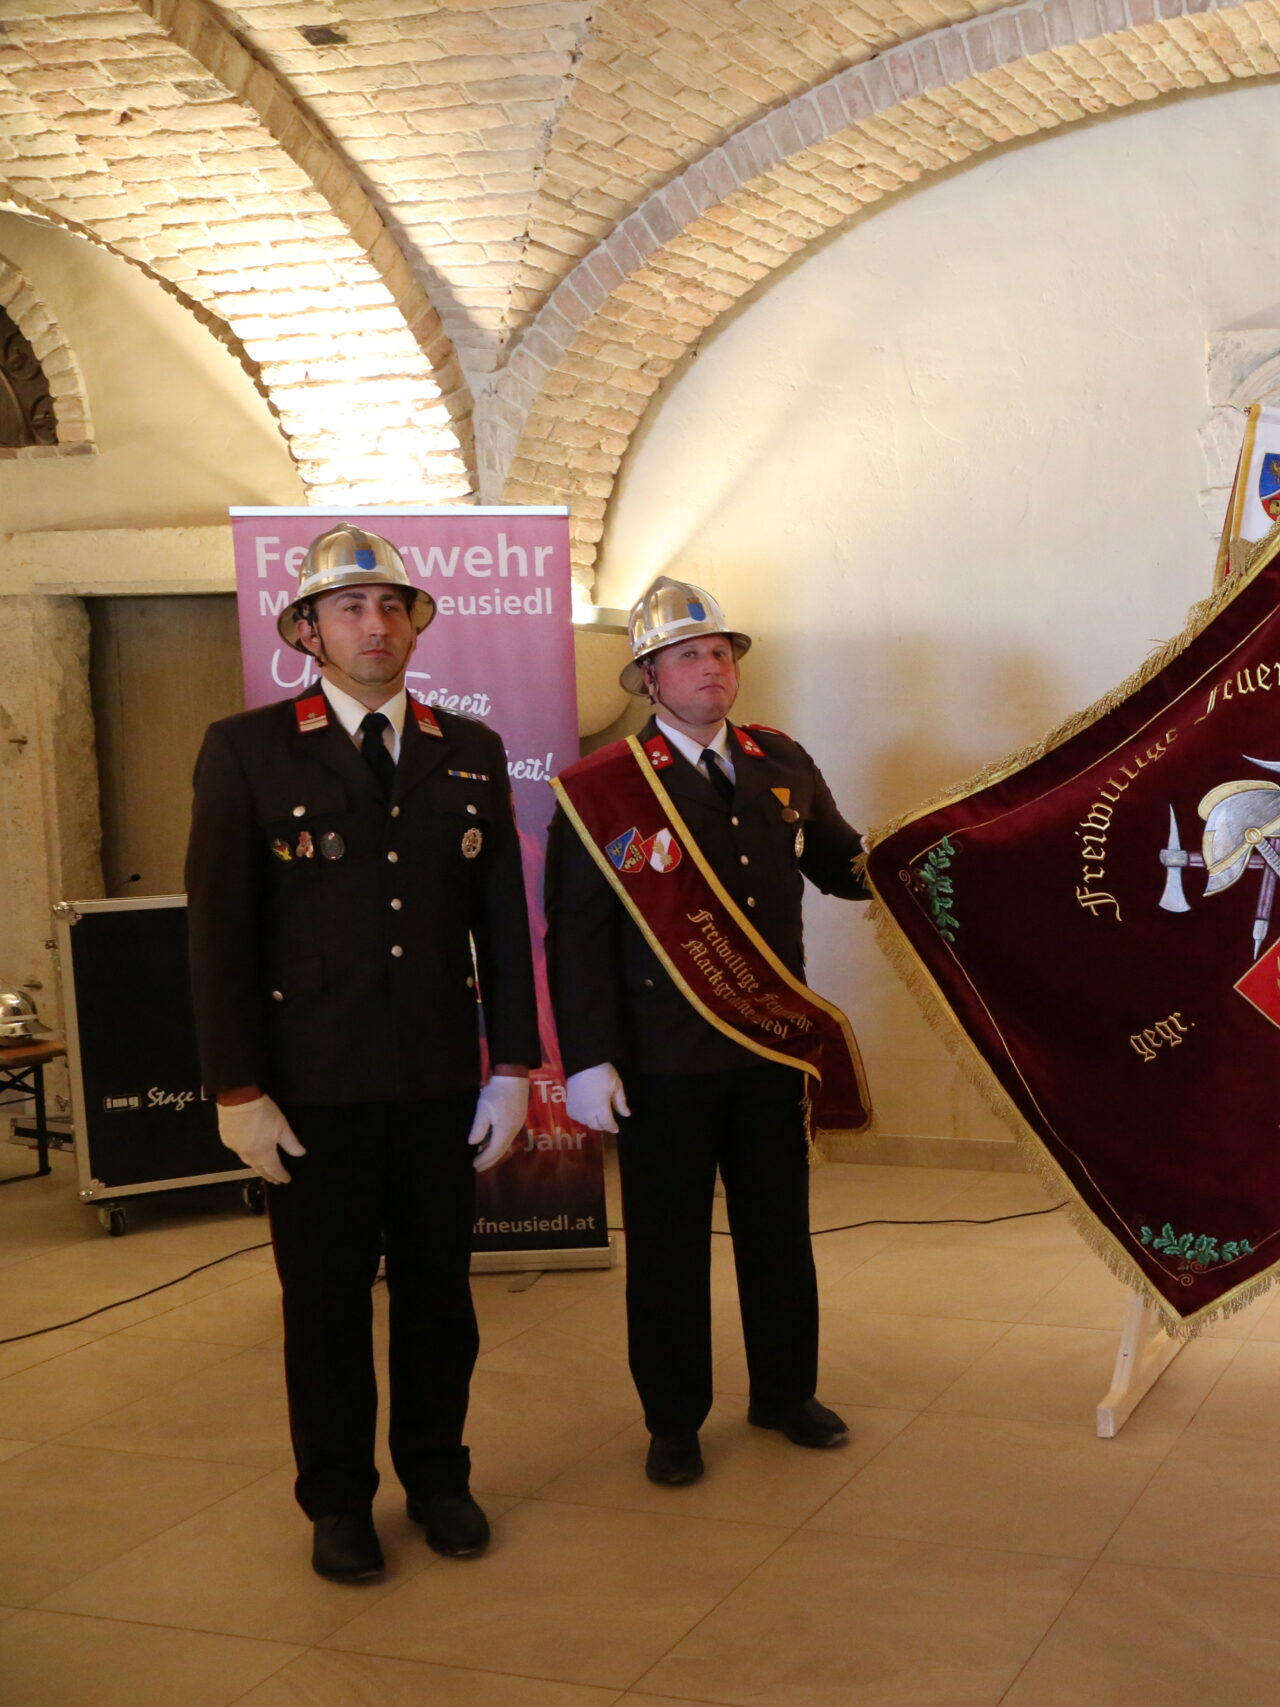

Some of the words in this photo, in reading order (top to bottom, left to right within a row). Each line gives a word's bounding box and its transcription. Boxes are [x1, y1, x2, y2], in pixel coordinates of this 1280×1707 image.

[1075, 726, 1179, 922] Freiwillige
[686, 908, 760, 994] Freiwillige
[1130, 1011, 1196, 1063] gegr.
[146, 1086, 196, 1112] Stage
[523, 1126, 588, 1152] Jahr
